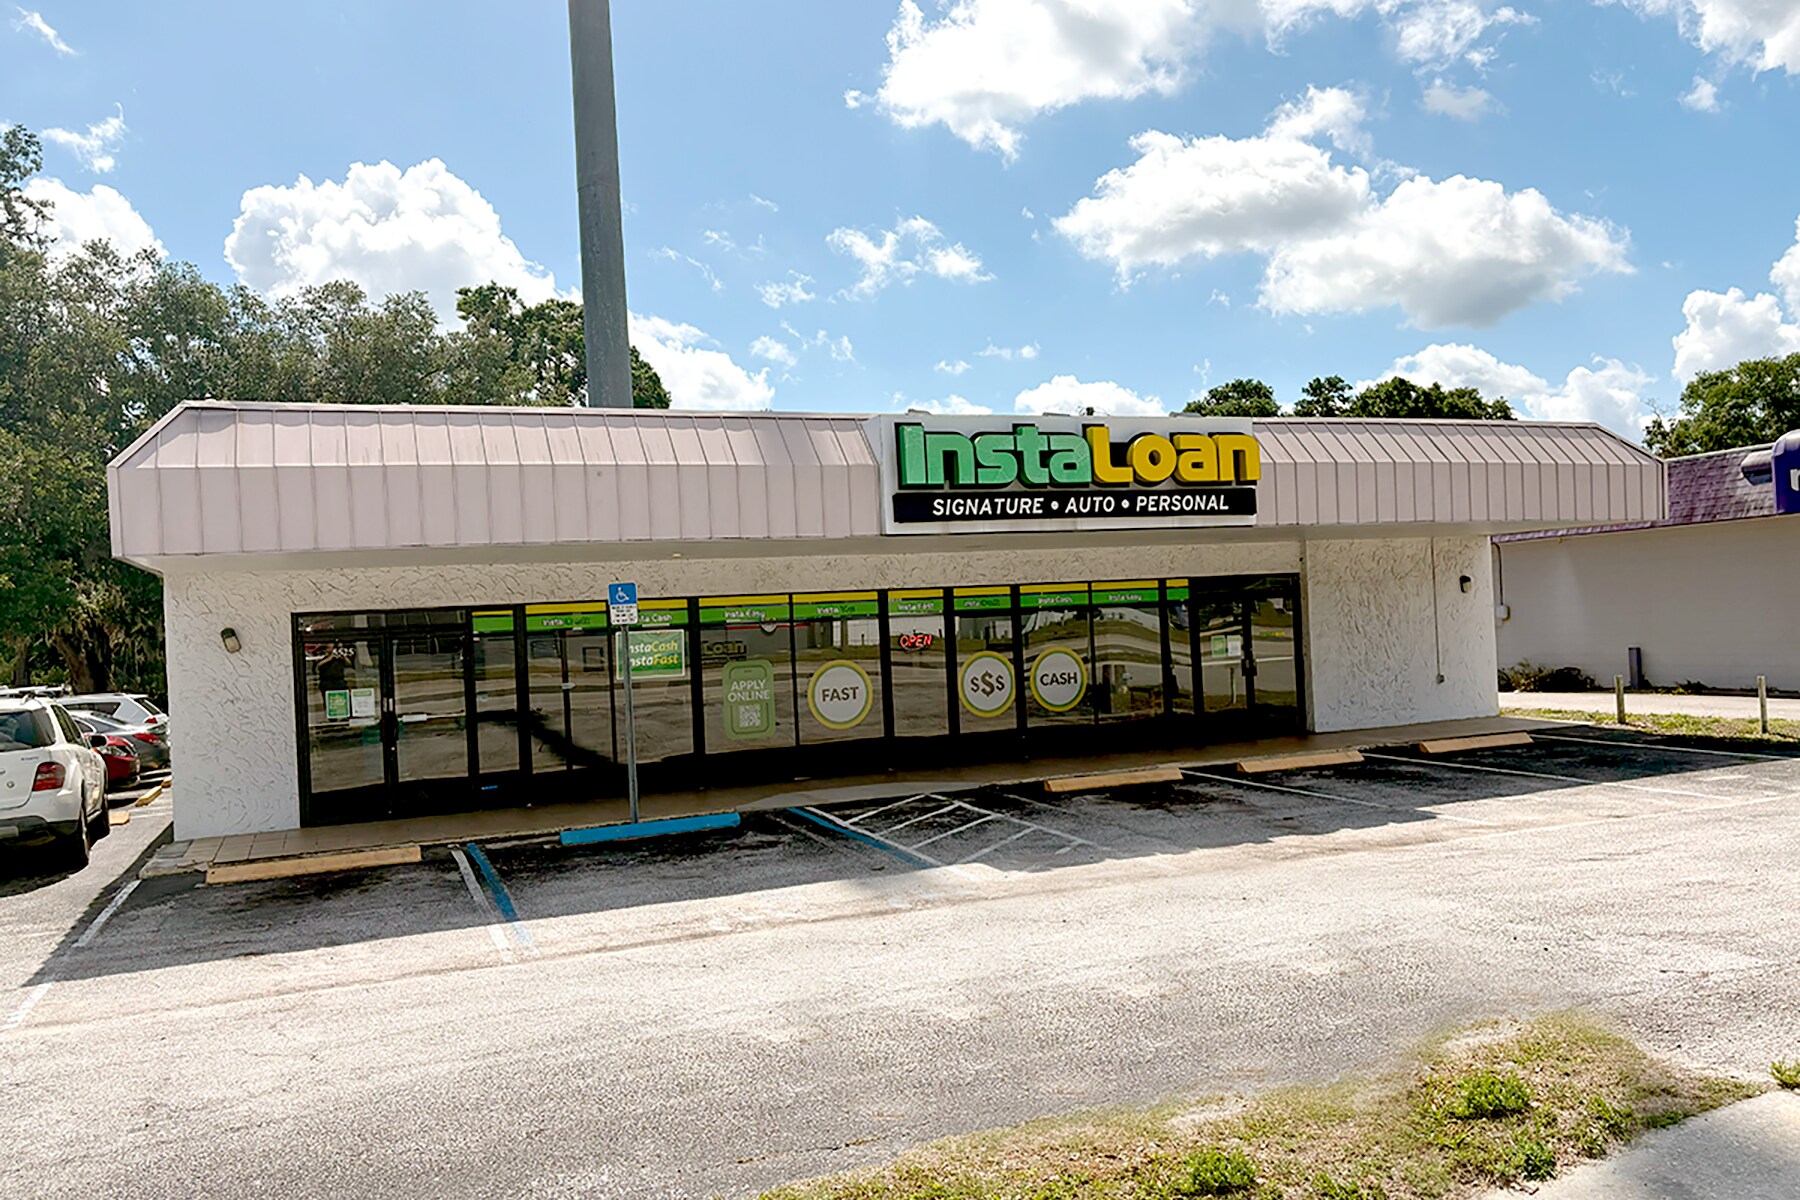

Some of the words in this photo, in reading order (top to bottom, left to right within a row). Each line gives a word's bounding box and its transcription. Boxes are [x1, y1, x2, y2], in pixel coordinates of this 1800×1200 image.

[896, 423, 1261, 488] InstaLoan
[932, 498, 1045, 516] SIGNATURE
[1065, 496, 1116, 514] AUTO
[1136, 495, 1230, 513] PERSONAL
[630, 641, 678, 654] nstaCash
[900, 634, 933, 648] OPEN
[630, 655, 679, 667] nstaFast
[730, 679, 767, 692] APPLY
[1039, 671, 1079, 687] CASH
[727, 690, 771, 703] ONLINE
[821, 686, 860, 702] FAST
